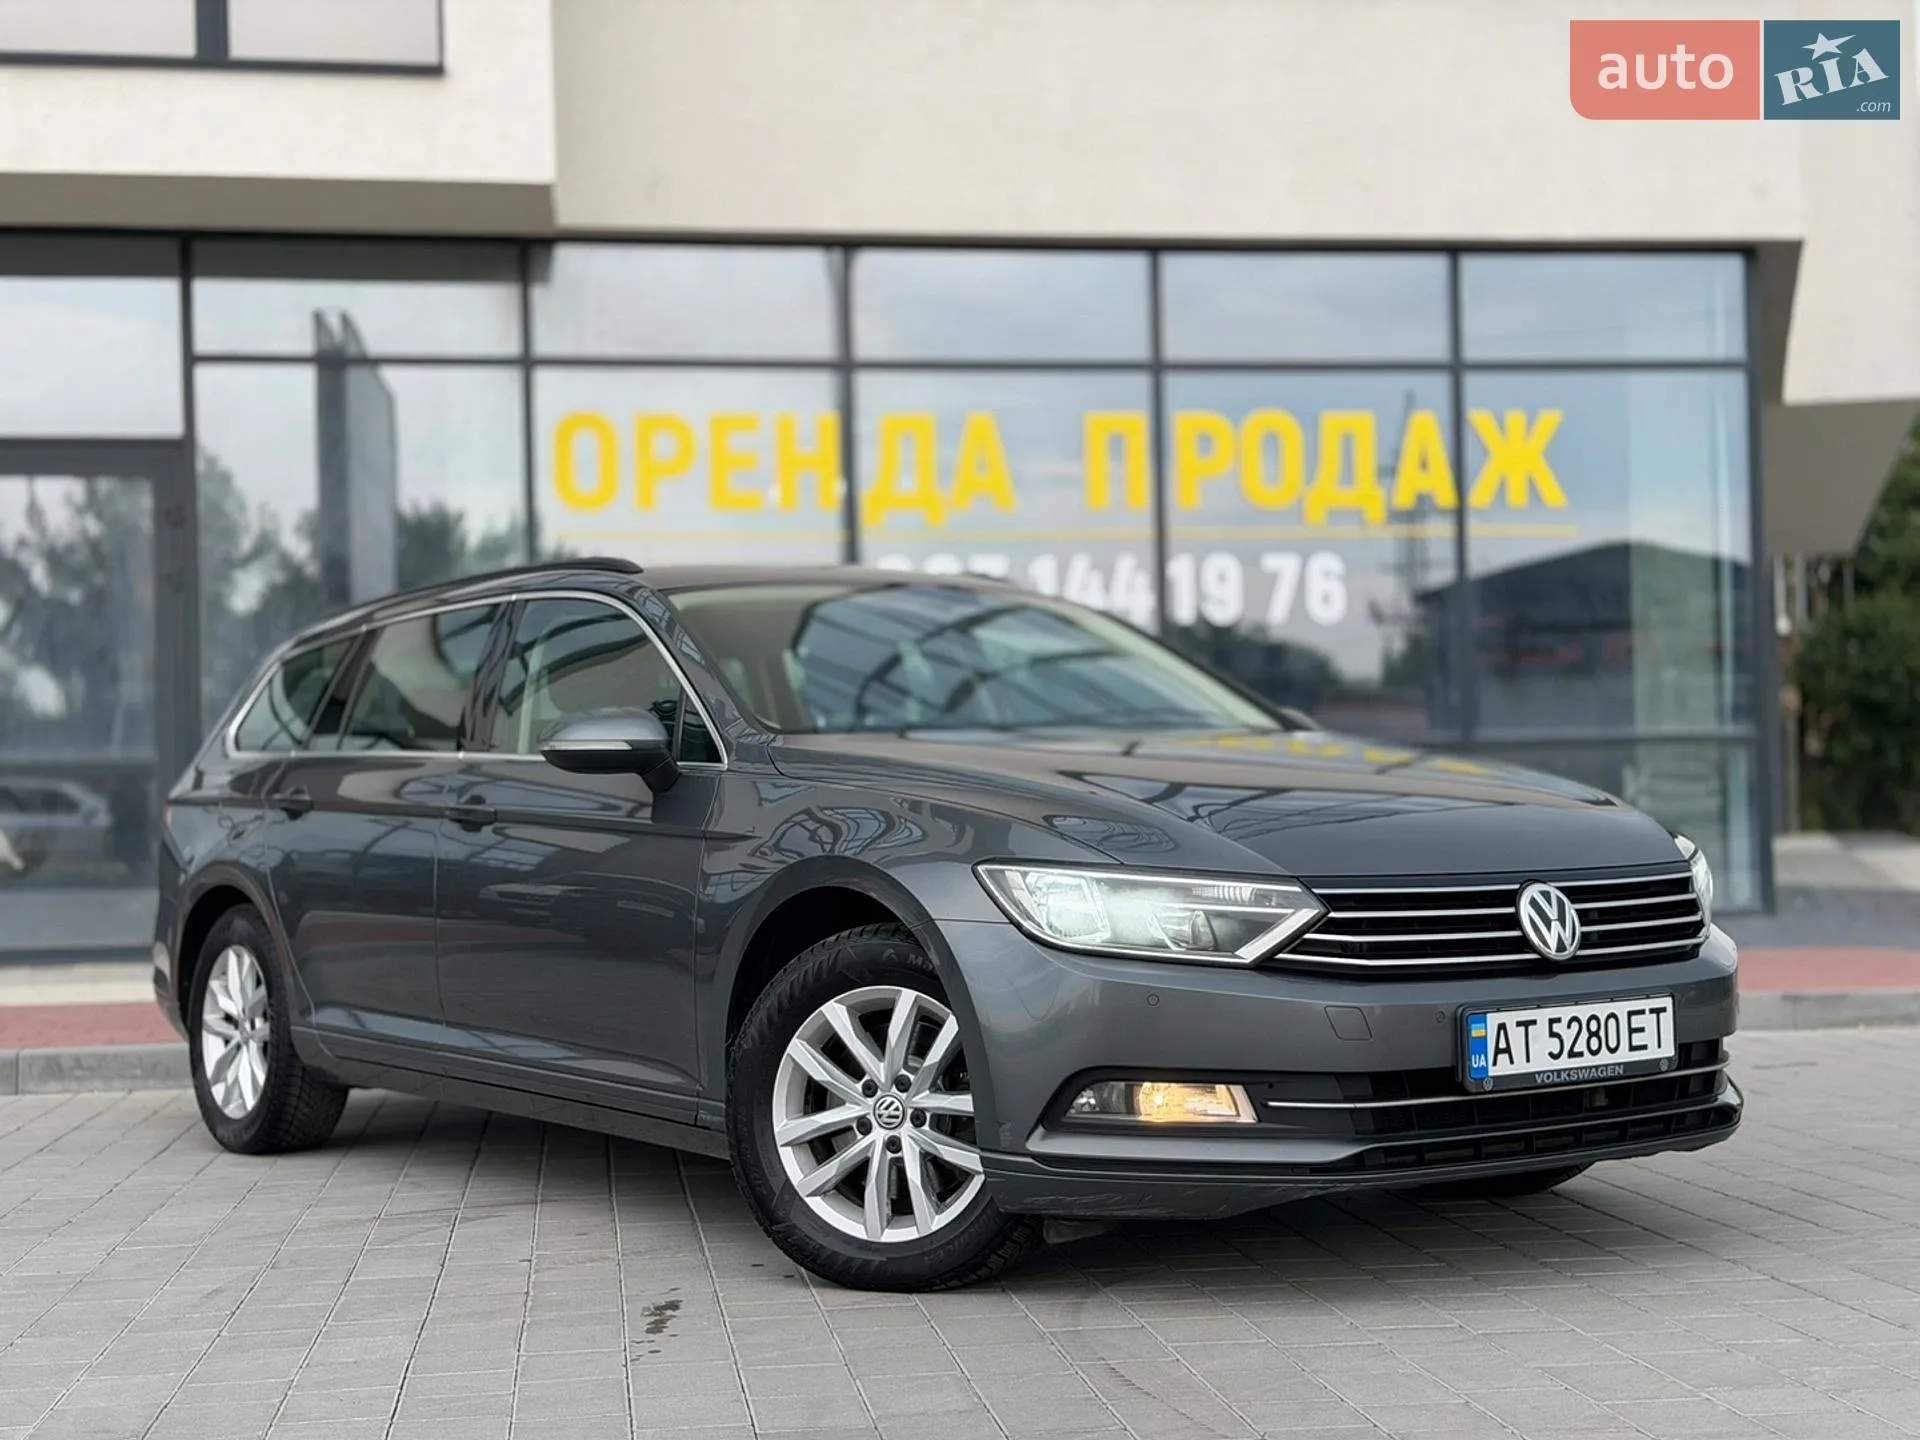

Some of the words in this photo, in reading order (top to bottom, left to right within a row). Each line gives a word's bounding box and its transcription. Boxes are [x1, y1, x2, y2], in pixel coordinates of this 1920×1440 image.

[552, 410, 1018, 527] ОРЕНДА
[1083, 407, 1570, 525] ПРОДАЖ
[1260, 550, 1349, 626] 76
[1471, 1053, 1488, 1069] UA
[1491, 1018, 1538, 1067] AT
[1547, 1011, 1621, 1060] 5280
[1626, 1006, 1668, 1052] ET
[1535, 1065, 1624, 1085] VOLKSWAGEN
